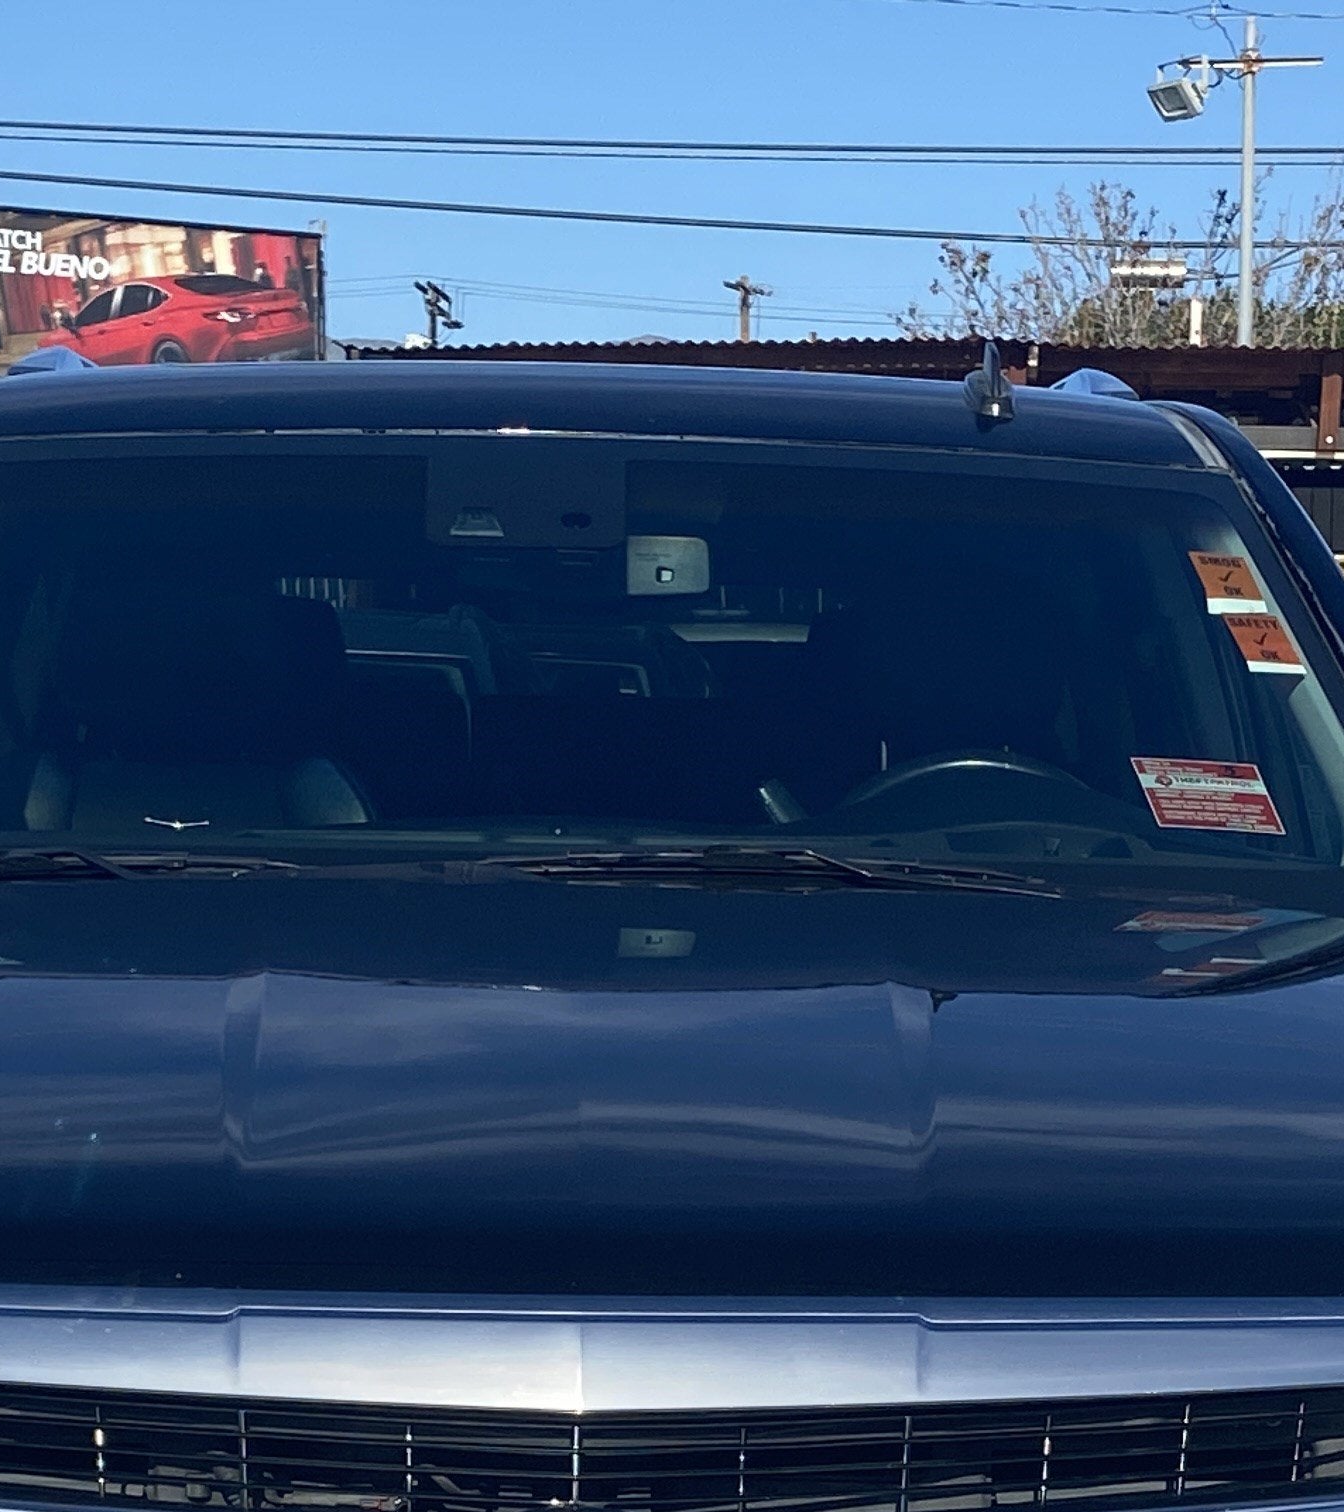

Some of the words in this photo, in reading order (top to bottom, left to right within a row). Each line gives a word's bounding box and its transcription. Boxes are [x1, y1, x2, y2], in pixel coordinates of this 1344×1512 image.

[20, 253, 110, 280] BUENO
[1199, 556, 1242, 567] SMOG
[1223, 586, 1244, 596] OK
[1228, 617, 1278, 629] SAFETY
[1260, 650, 1280, 660] OK
